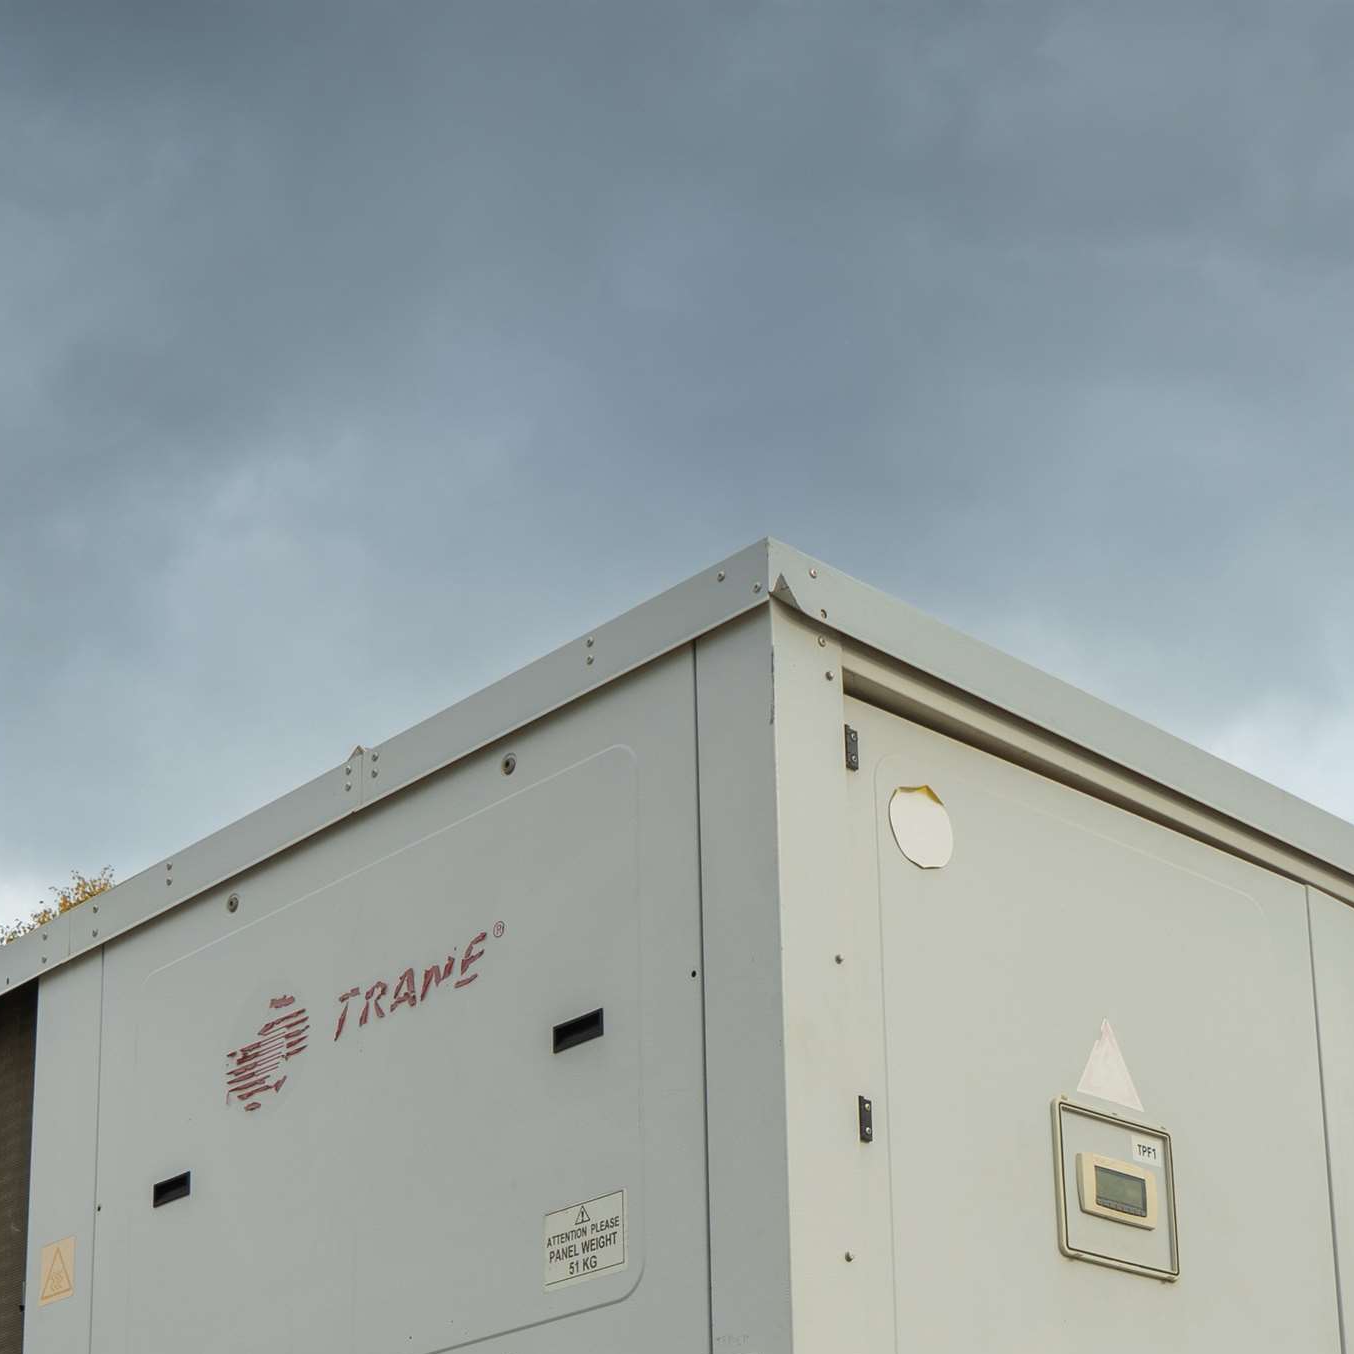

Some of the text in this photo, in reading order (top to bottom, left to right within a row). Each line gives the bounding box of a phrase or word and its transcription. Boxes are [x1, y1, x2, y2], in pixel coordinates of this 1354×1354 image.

[546, 1215, 620, 1248] ATTENTION PLEASE
[549, 1231, 617, 1263] PANEL WEIGHT
[569, 1255, 597, 1275] 51 KG
